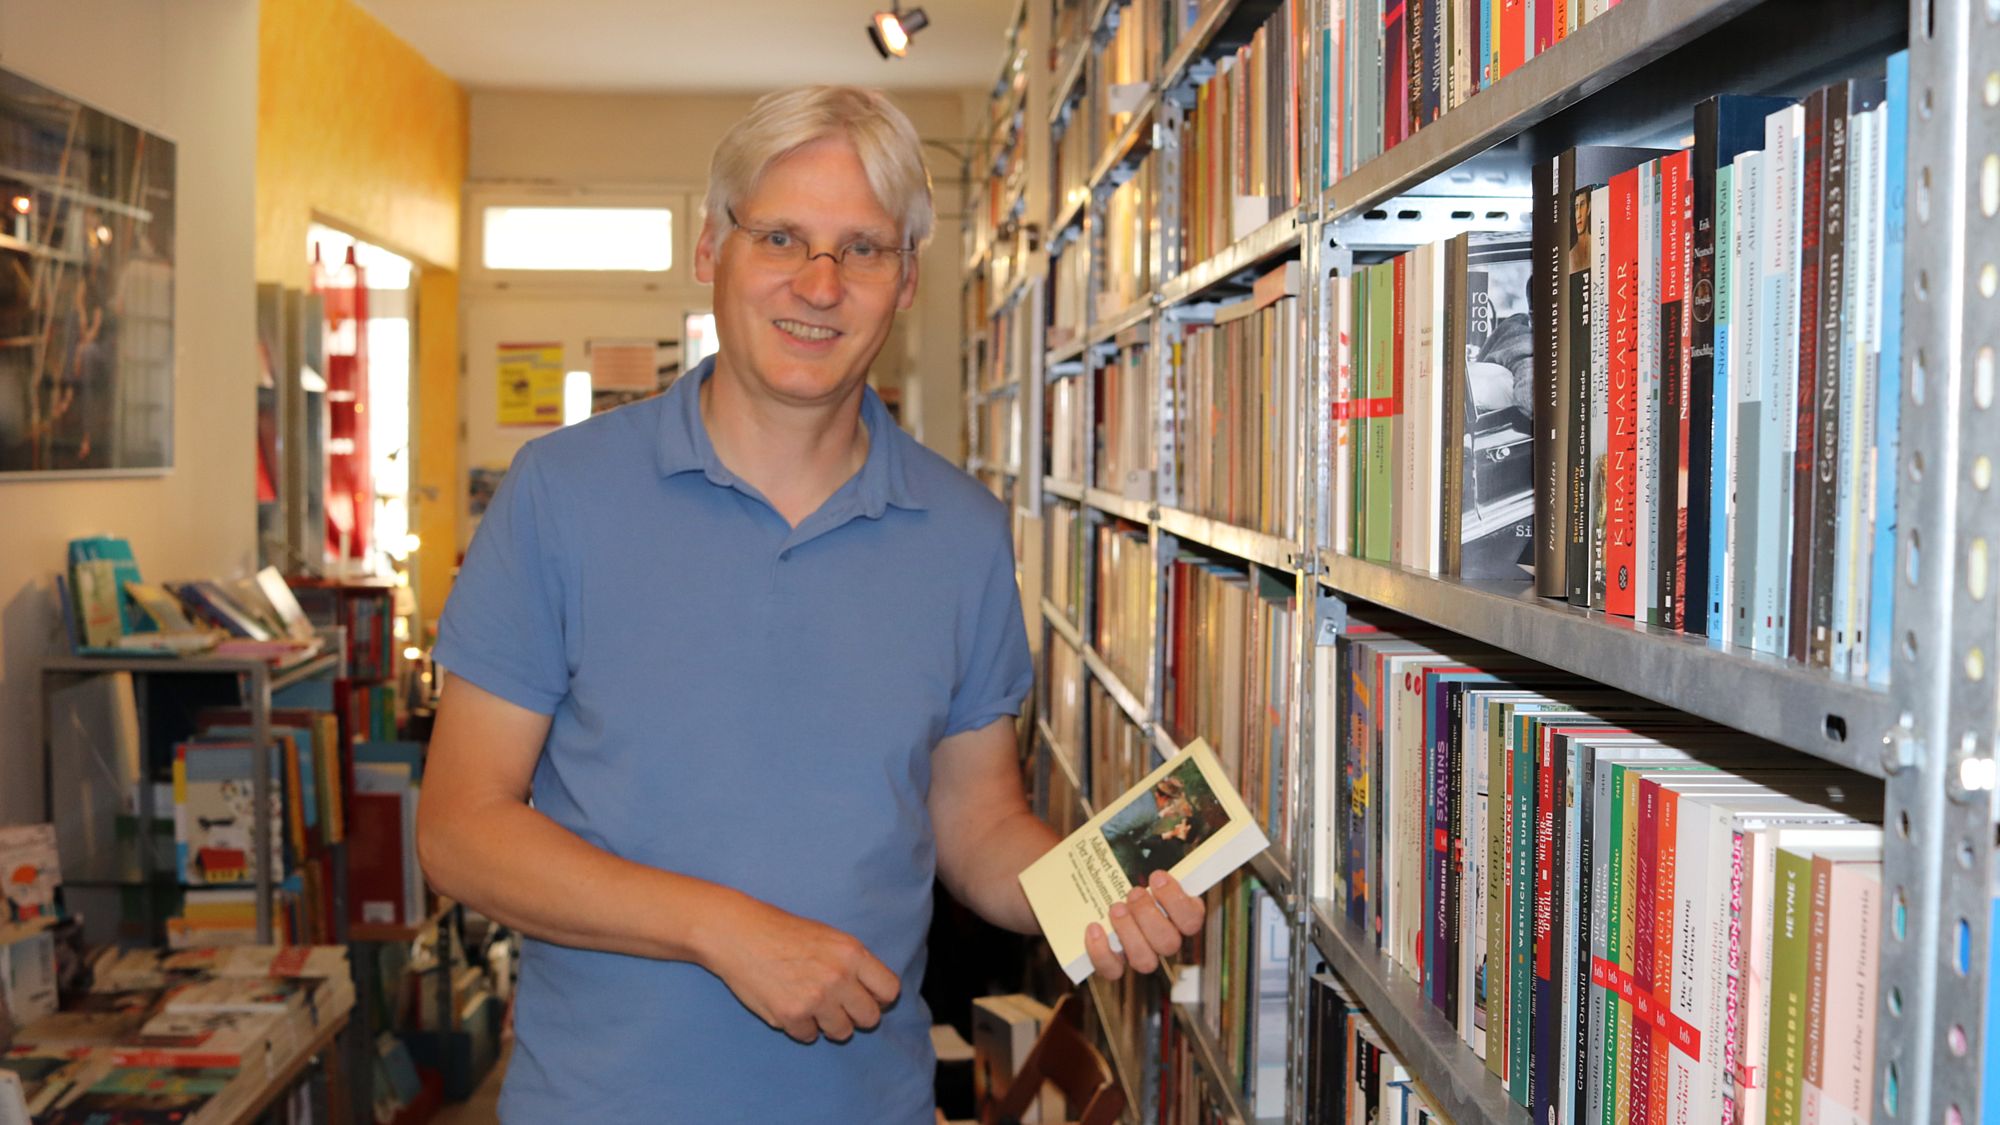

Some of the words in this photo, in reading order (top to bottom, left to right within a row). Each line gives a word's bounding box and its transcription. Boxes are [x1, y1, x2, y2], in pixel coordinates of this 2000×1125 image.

[1412, 2, 1421, 50] Moers
[1412, 52, 1421, 101] Walter
[1432, 41, 1440, 92] Walter
[1828, 118, 1845, 182] Tage
[1670, 166, 1678, 216] Frauen
[1720, 179, 1728, 216] Wals
[1748, 166, 1757, 251] Allerseelen
[1829, 187, 1842, 234] 533
[1669, 218, 1677, 261] starke
[1719, 219, 1727, 245] des
[1775, 218, 1783, 268] Berlin
[1472, 292, 1489, 304] ro
[1682, 232, 1690, 338] Sommerstarre
[1719, 249, 1727, 295] Bauch
[1471, 319, 1488, 332] ro
[1472, 305, 1488, 319] ro
[1591, 281, 1600, 364] Nadolny
[1598, 253, 1606, 357] Entdeckung
[1628, 258, 1638, 353] Krieger
[1719, 299, 1726, 320] Im
[1746, 261, 1754, 356] Nooteboom
[1772, 279, 1781, 377] Nooteboom
[1615, 261, 1627, 437] NAGARKAR
[1668, 307, 1676, 360] NDiaye
[1718, 330, 1726, 376] Nizon
[1823, 253, 1839, 411] Nooteboom
[1680, 346, 1688, 420] Neumeyer
[1744, 359, 1752, 397] Cees
[1626, 364, 1637, 451] kleiner
[1820, 421, 1832, 483] Cees
[1573, 466, 1581, 514] Nadolny
[1614, 451, 1624, 546] KIRAN
[1625, 462, 1635, 547] Gottes
[1436, 740, 1445, 822] STALINS
[1545, 811, 1553, 841] LAND
[1075, 839, 1088, 857] Der
[1084, 855, 1113, 906] Nachsomm
[1090, 836, 1112, 872] Adalbert
[1490, 835, 1499, 900] Henry
[1626, 821, 1636, 922] Berlinreise
[1639, 858, 1647, 894] und
[1657, 848, 1667, 900] liebe
[1665, 845, 1674, 900] nicht
[1731, 836, 1742, 912] AMOUR
[1543, 889, 1551, 931] O'NEILL
[1611, 848, 1619, 924] Moselreise
[1785, 878, 1796, 938] HEYNE
[1816, 872, 1826, 907] Ilan
[1638, 897, 1646, 939] Stift
[1646, 886, 1655, 945] Papier
[1657, 911, 1665, 941] ich
[1681, 899, 1692, 975] Erfindung
[1814, 911, 1824, 937] Tel
[1856, 889, 1869, 978] Finsternis
[1625, 932, 1634, 961] Die
[1655, 949, 1663, 988] Was
[1729, 919, 1739, 971] MON
[1814, 942, 1823, 972] aus
[1607, 1000, 1615, 1052] Ortheil
[1725, 976, 1737, 1072] MARZAHN
[1855, 982, 1866, 1020] und
[1578, 1028, 1585, 1045] M.
[1808, 976, 1821, 1082] Geschichten
[1852, 1024, 1863, 1072] Liebe
[1577, 1049, 1585, 1091] Georg
[1592, 1054, 1600, 1113] Angelika
